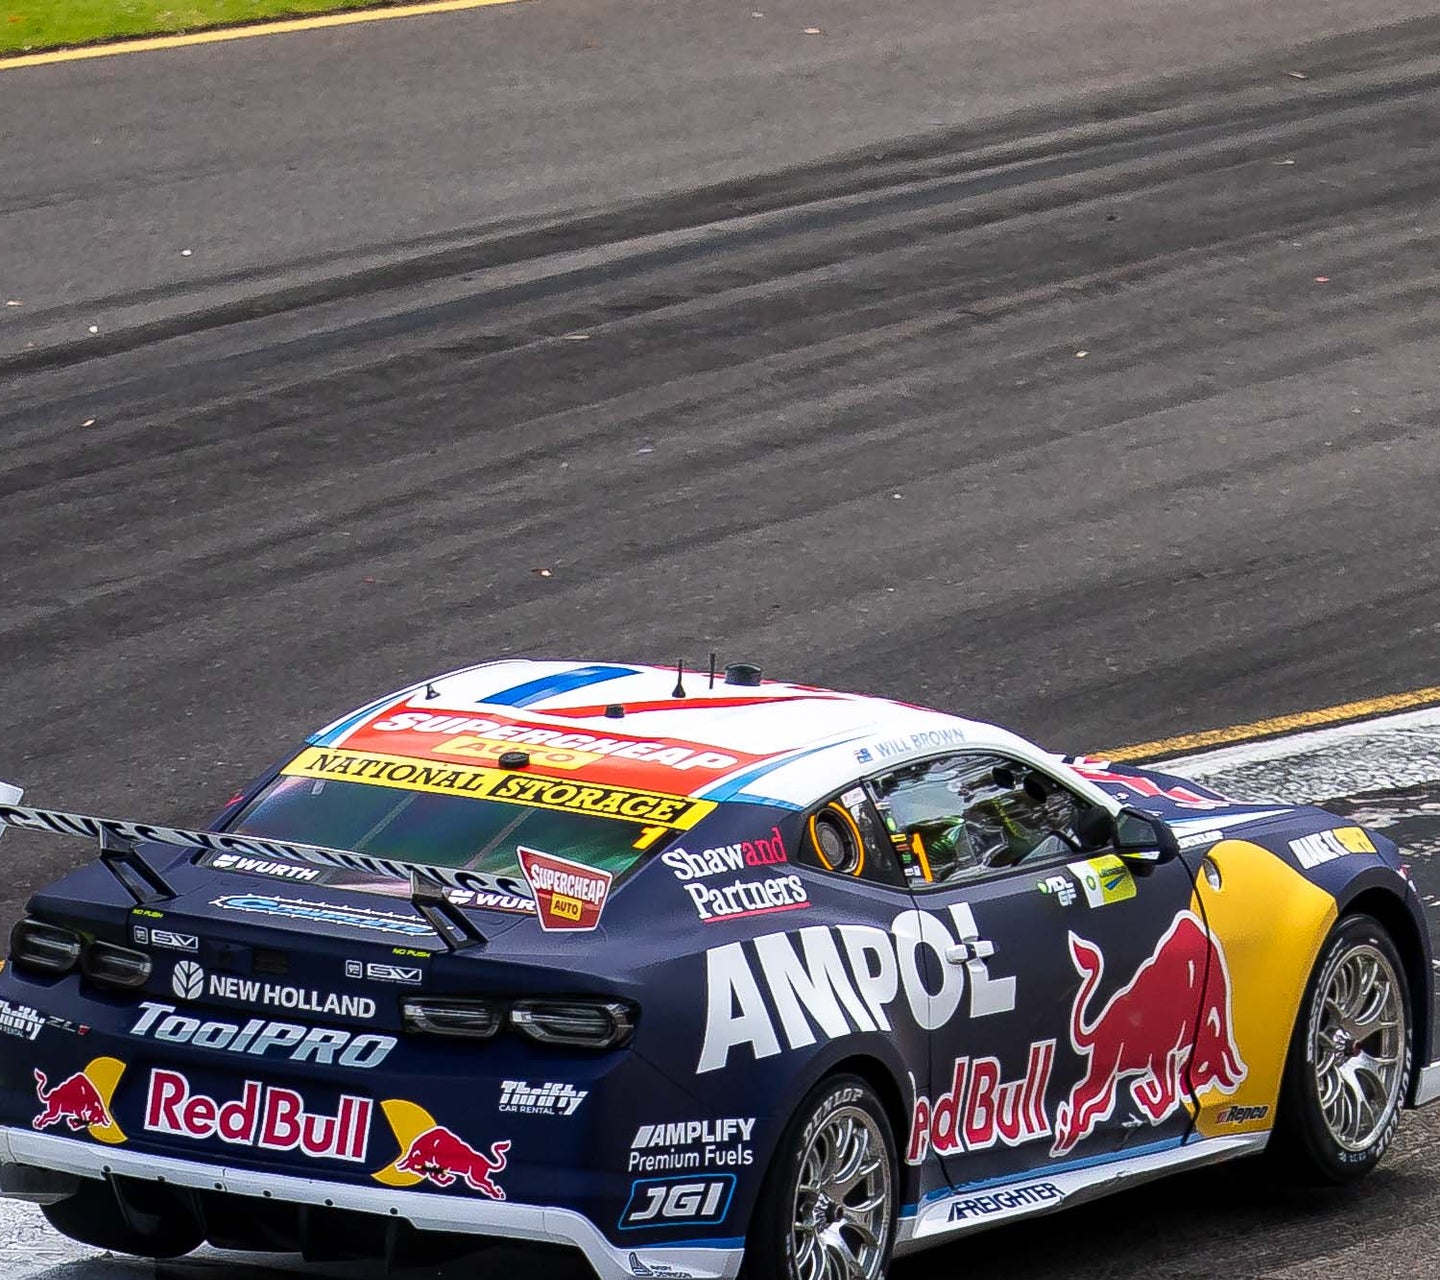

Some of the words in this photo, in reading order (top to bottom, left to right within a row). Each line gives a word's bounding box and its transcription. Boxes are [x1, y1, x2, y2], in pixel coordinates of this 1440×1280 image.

[371, 712, 738, 770] SUPERCHEAP
[874, 738, 911, 758] WILL
[910, 728, 965, 747] BROWN
[305, 753, 486, 792] NATIONAL
[501, 777, 686, 822] STORAGE
[631, 827, 669, 850] 1
[235, 857, 321, 881] WURTH
[911, 833, 934, 884] 1
[475, 891, 536, 911] WUR
[530, 863, 606, 906] SUPERCHEAP
[683, 875, 809, 920] Partners
[554, 900, 579, 916] AUTO
[209, 975, 261, 1001] NEW
[263, 983, 376, 1019] HOLLAND
[696, 902, 1017, 1075] AMPOL
[129, 1001, 398, 1069] ToolPRO
[499, 1080, 589, 1116] Thrifty
[499, 1104, 517, 1112] CAR
[520, 1105, 555, 1115] RENTAL
[963, 1037, 1057, 1153] Bull
[648, 1118, 756, 1147] AMPLIFY
[803, 1088, 864, 1148] DUNLOP
[628, 1149, 700, 1172] Premium
[704, 1145, 754, 1167] Fuels
[628, 1182, 724, 1221] JGI
[954, 1182, 1066, 1220] FREIGHTER
